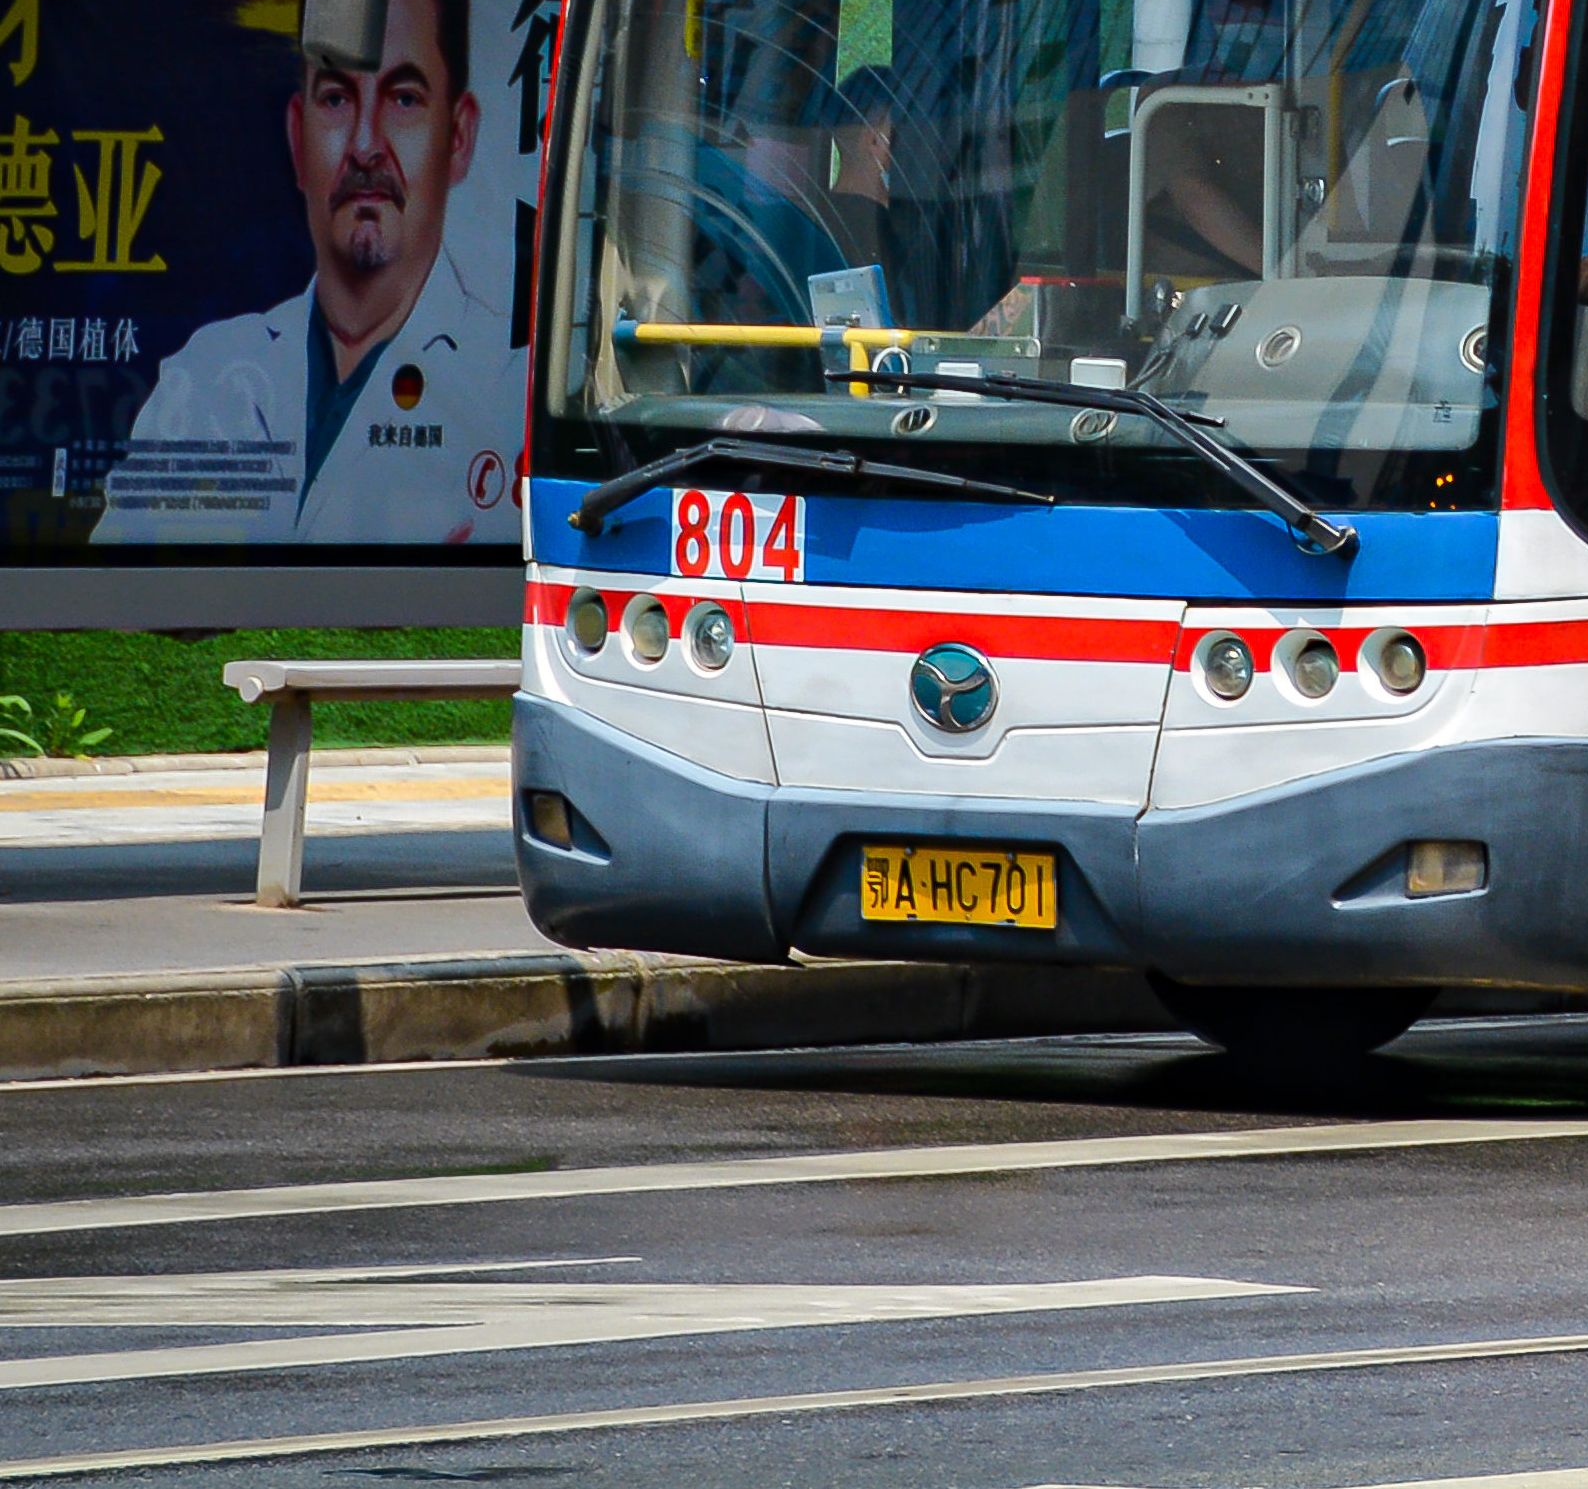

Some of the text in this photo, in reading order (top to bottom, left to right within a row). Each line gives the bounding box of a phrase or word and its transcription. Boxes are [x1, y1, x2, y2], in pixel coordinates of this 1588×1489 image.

[0, 317, 140, 362] /德国植体
[368, 422, 444, 448] 我来自德国
[674, 488, 801, 581] 804
